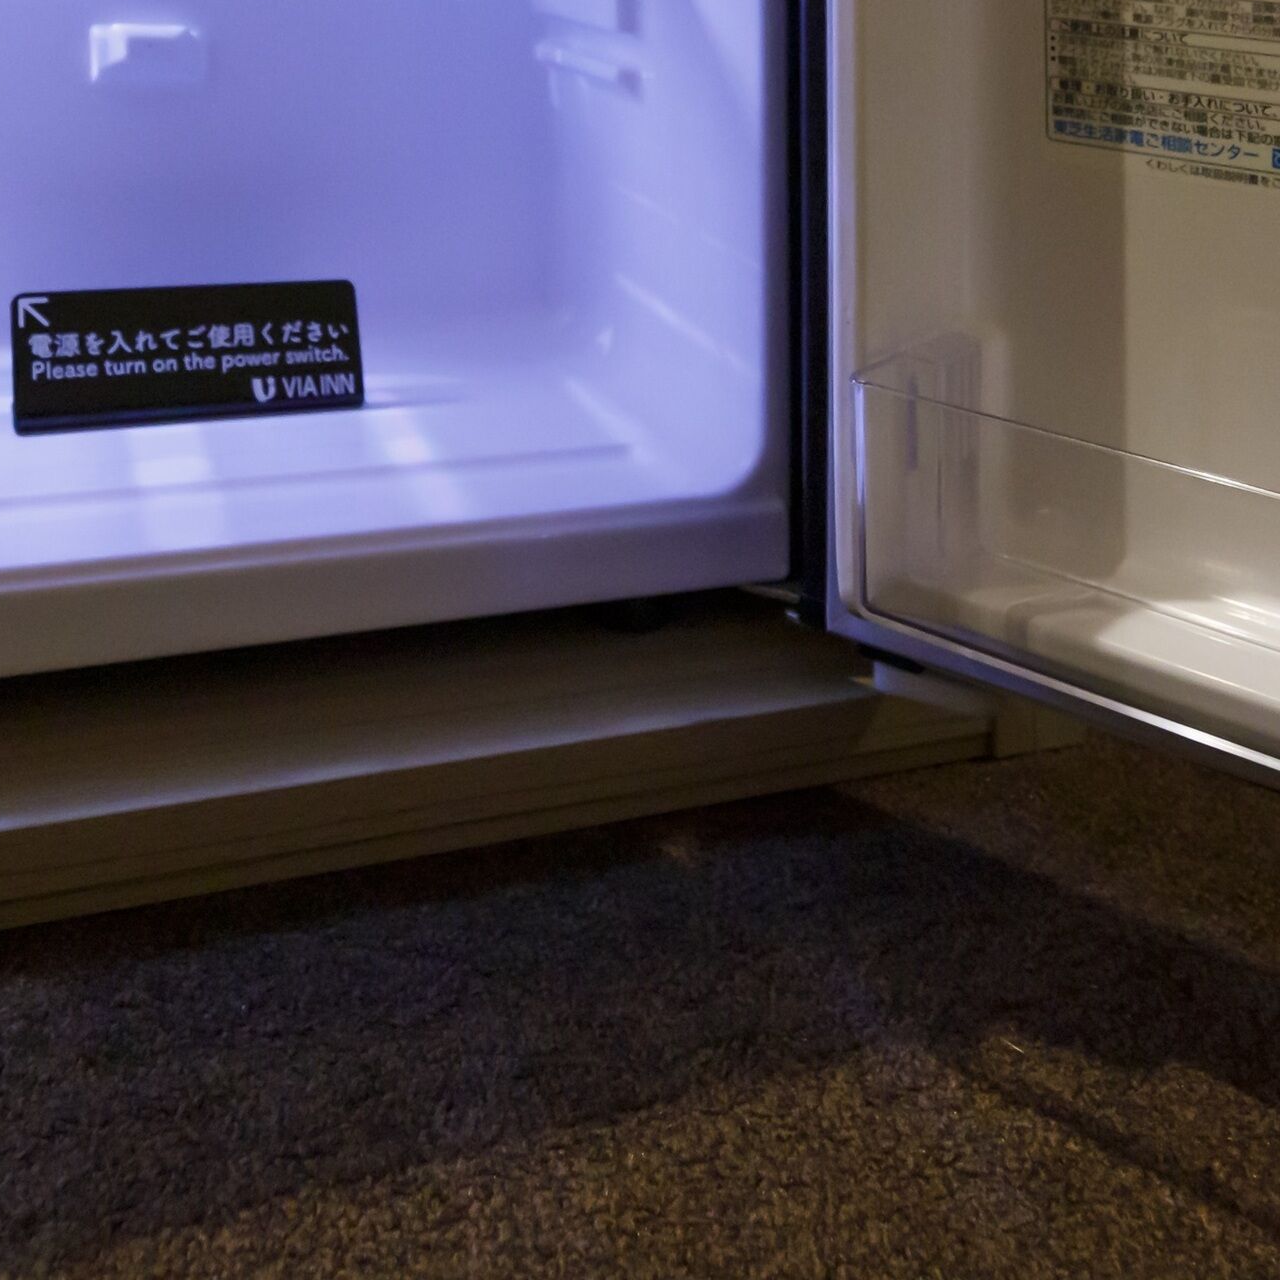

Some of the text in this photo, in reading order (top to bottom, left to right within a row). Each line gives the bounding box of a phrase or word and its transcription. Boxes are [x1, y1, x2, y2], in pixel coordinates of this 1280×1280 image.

[27, 321, 350, 358] 電源を入れてご使用ください
[32, 344, 350, 380] Please turn on the power switch.
[282, 374, 355, 398] VIA INN
